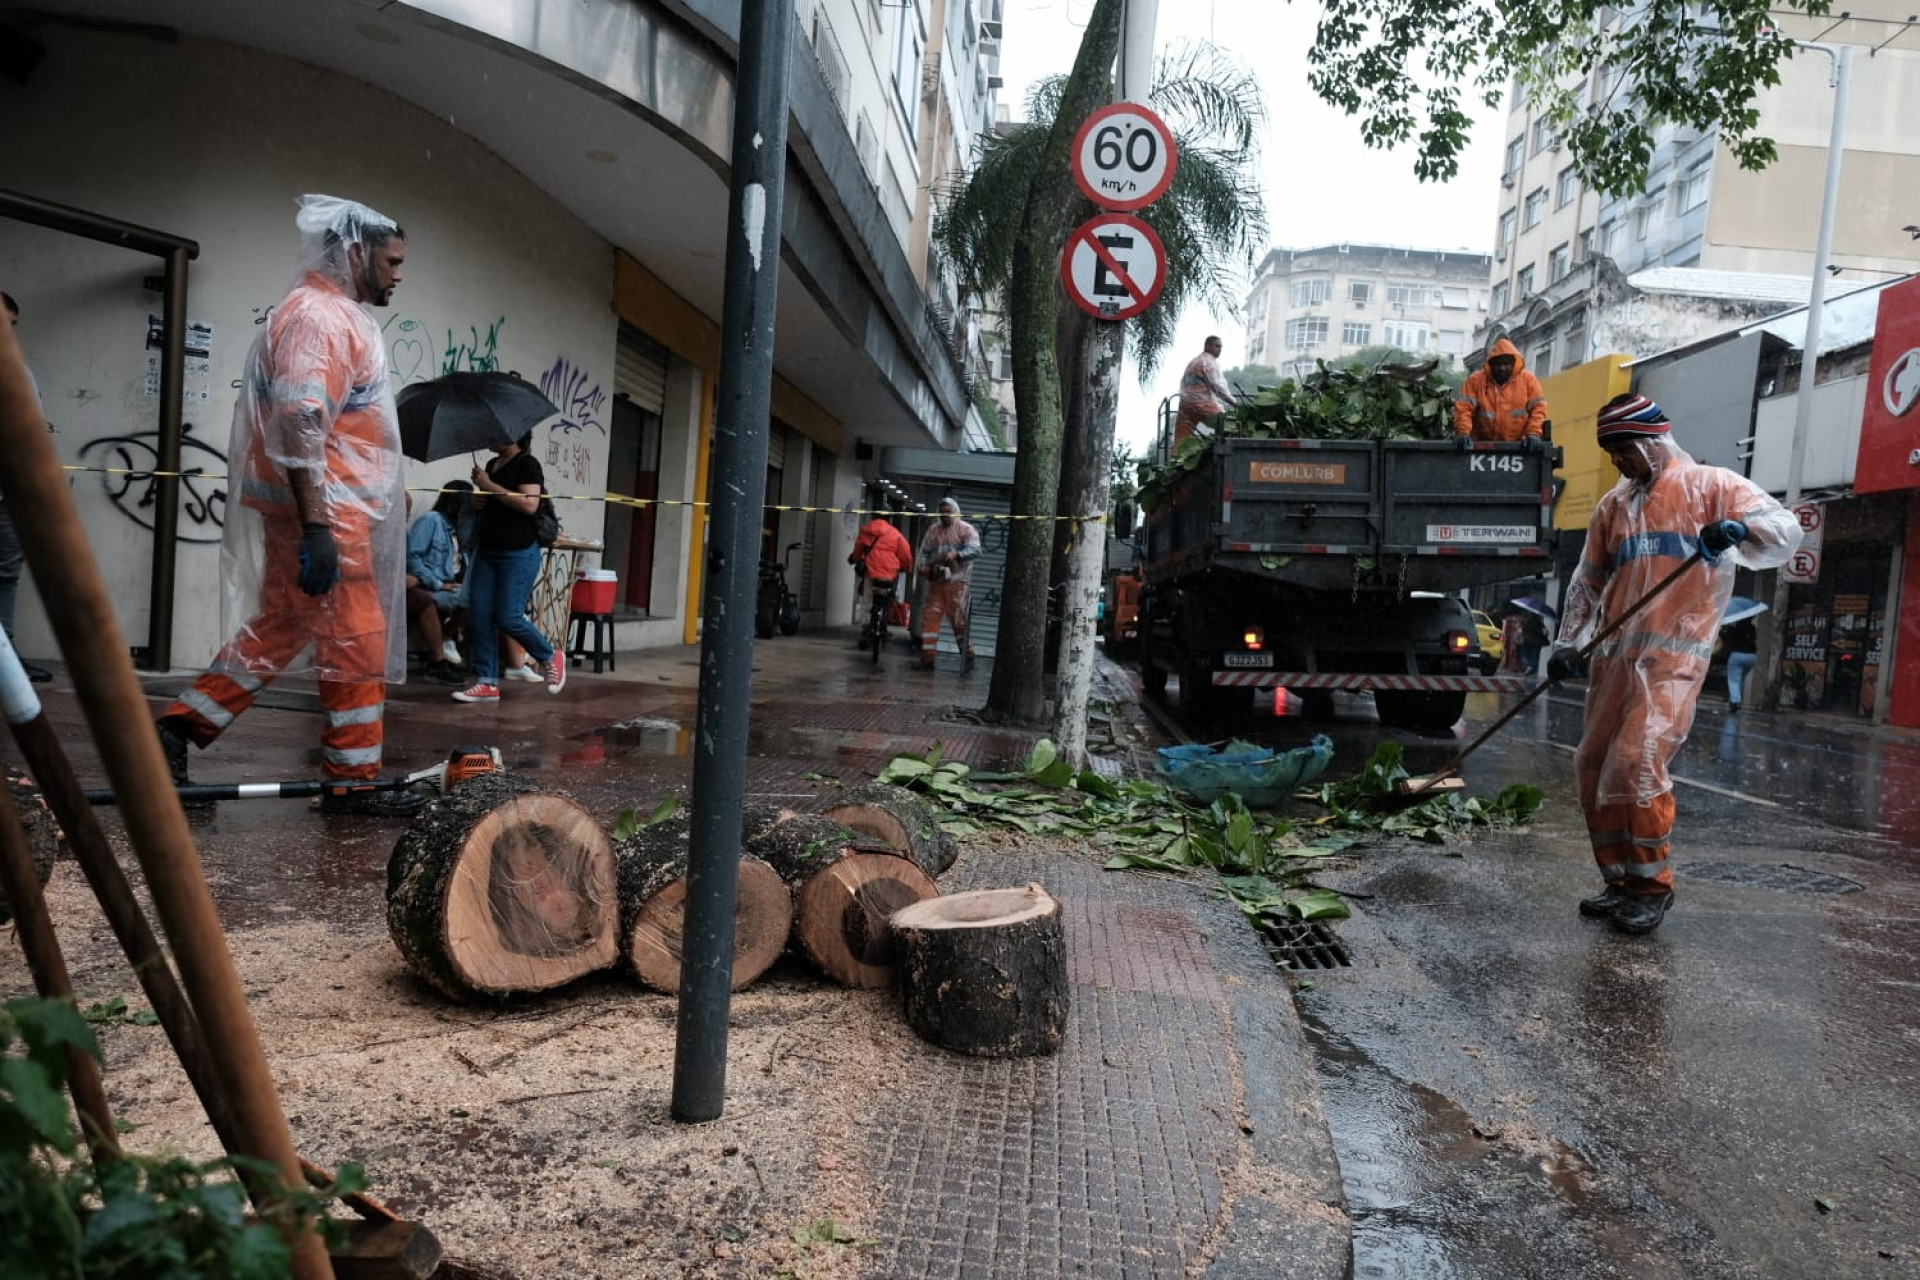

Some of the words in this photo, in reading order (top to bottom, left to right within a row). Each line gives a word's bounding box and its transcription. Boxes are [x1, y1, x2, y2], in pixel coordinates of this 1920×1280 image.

[1093, 126, 1157, 173] 60
[1101, 177, 1137, 193] km/h
[1093, 234, 1134, 298] E
[1470, 454, 1524, 473] K145
[1260, 466, 1335, 480] COMLURB
[1461, 528, 1531, 538] TERWAN
[1793, 634, 1819, 646] SELF
[1785, 647, 1826, 660] SERVICE
